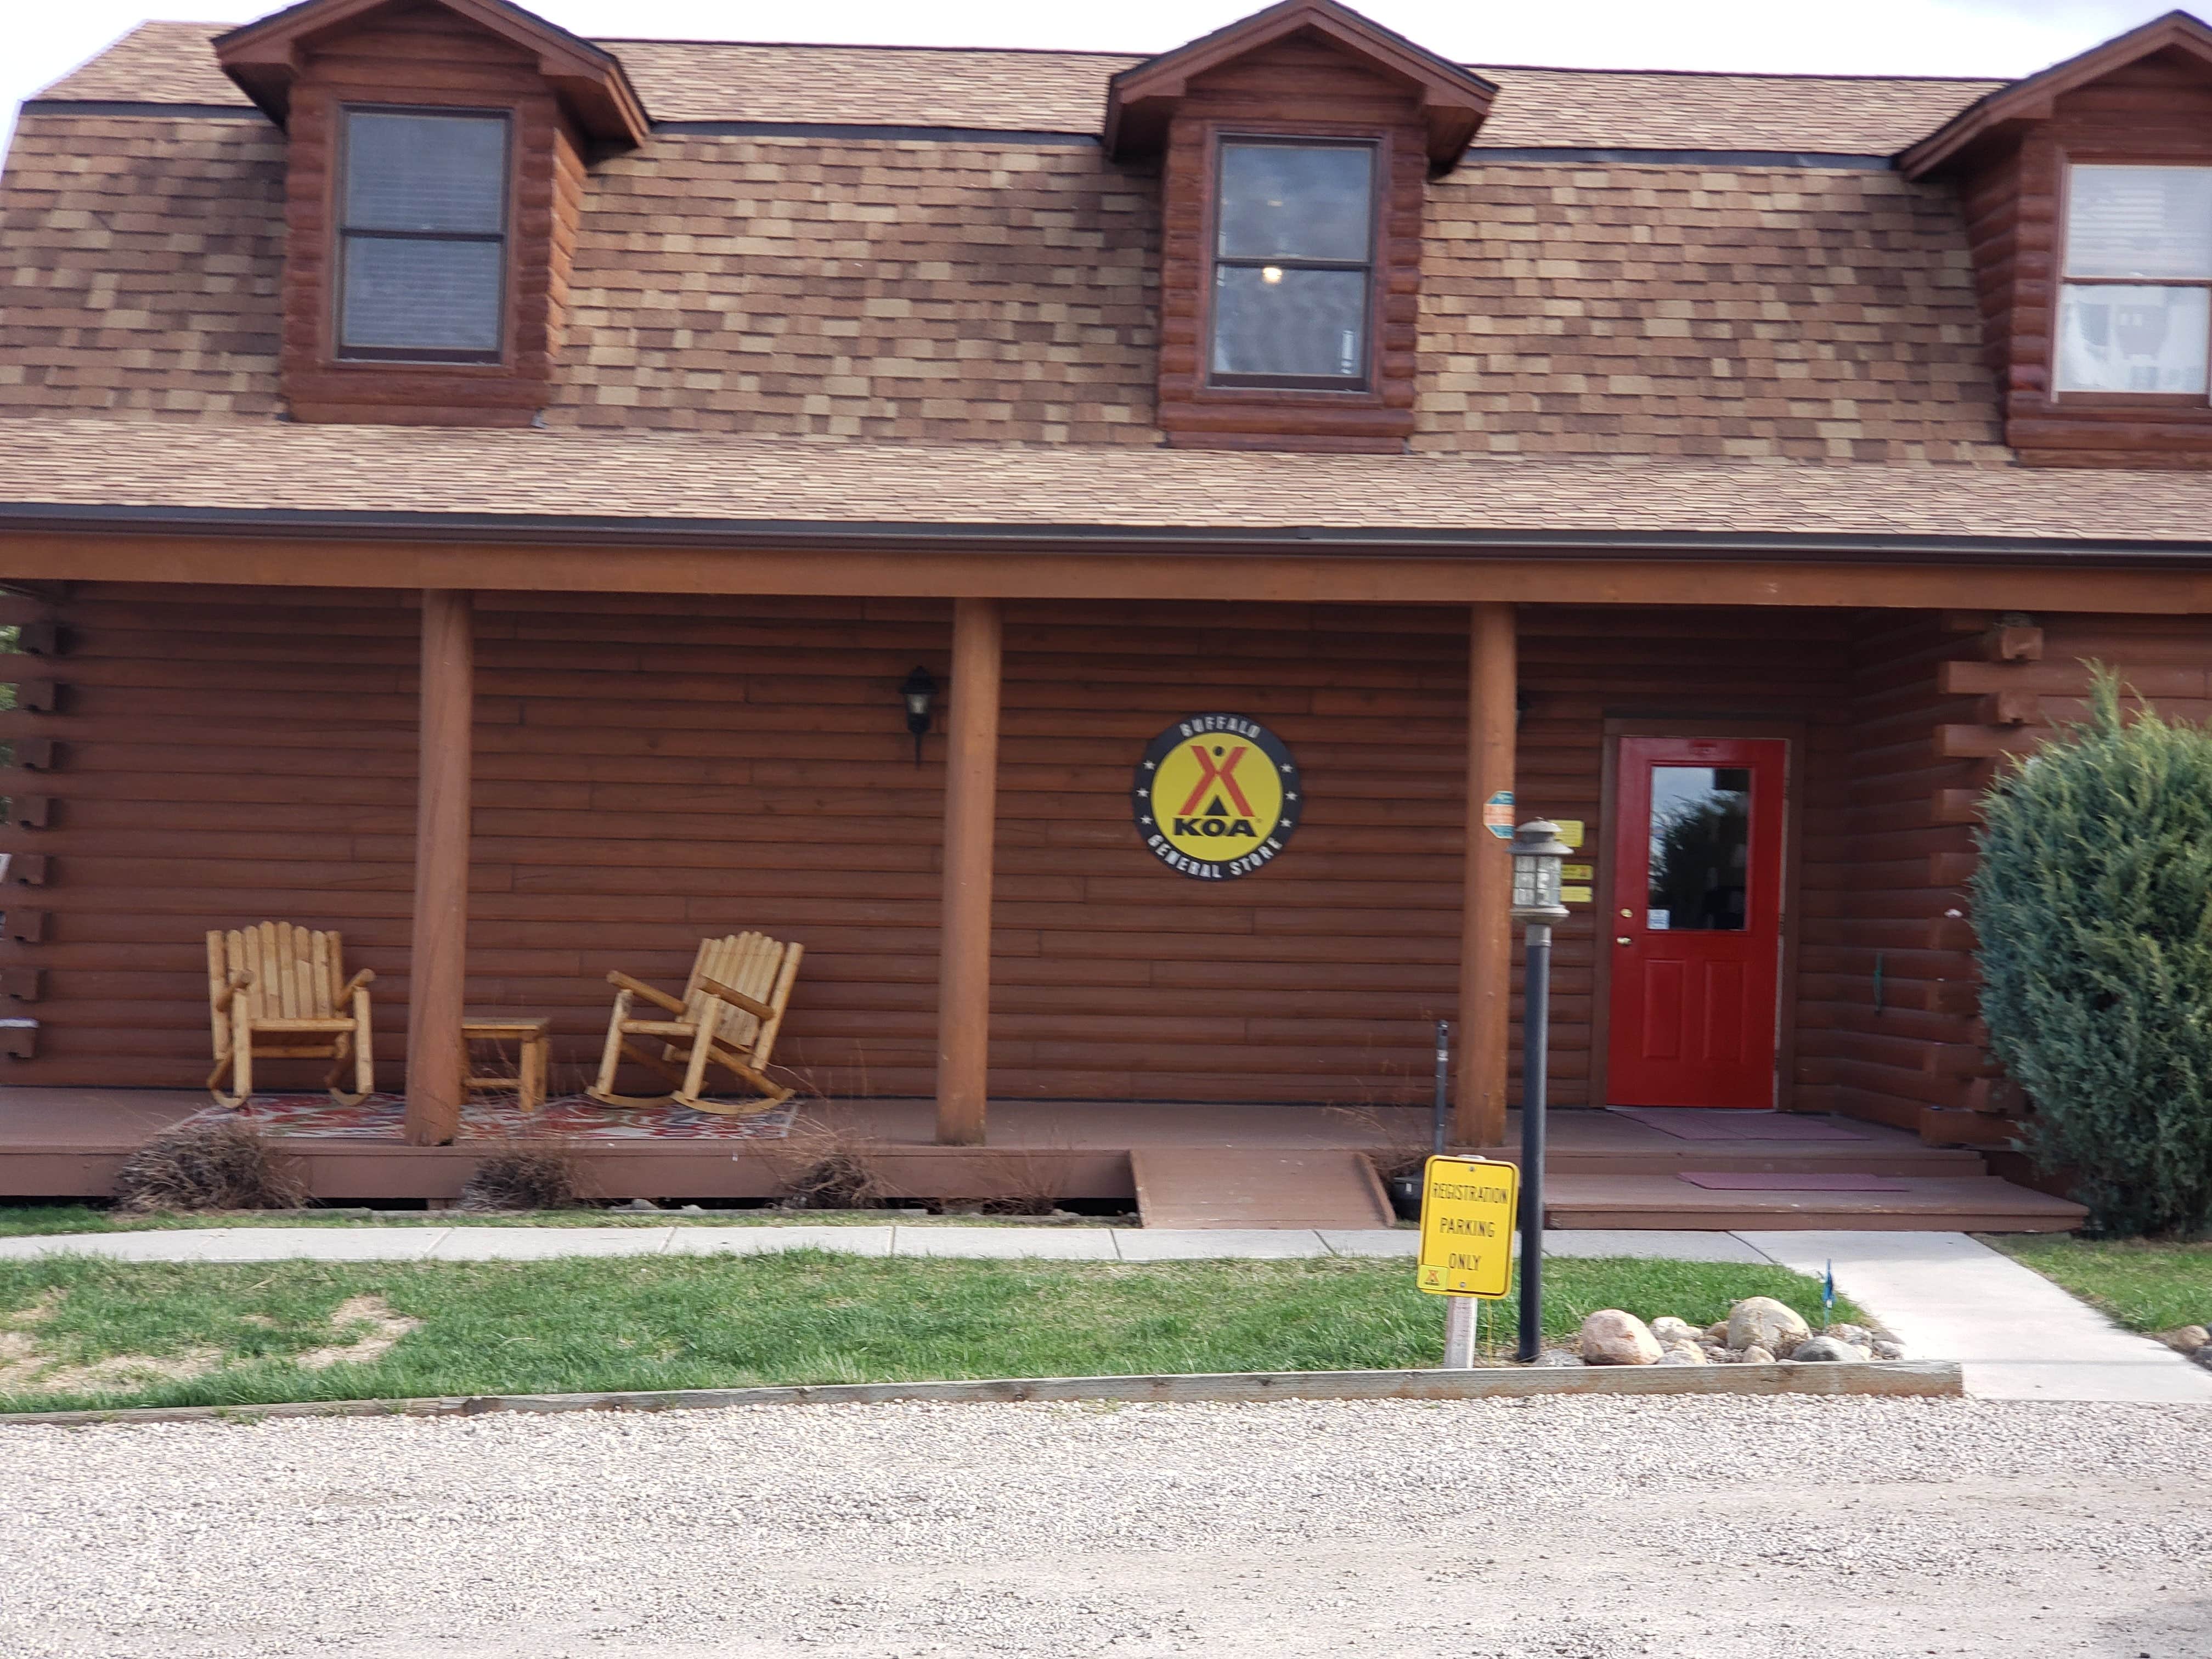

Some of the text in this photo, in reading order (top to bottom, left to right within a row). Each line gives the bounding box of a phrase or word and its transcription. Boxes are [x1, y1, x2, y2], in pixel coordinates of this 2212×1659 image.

[1179, 716, 1261, 738] BUFFALO
[1172, 817, 1258, 838] KOA
[1148, 834, 1283, 878] GENERAL STORE
[1432, 1182, 1509, 1204] REGISTRATION
[1440, 1217, 1496, 1238] PARKING
[1448, 1252, 1481, 1271] ONLY
